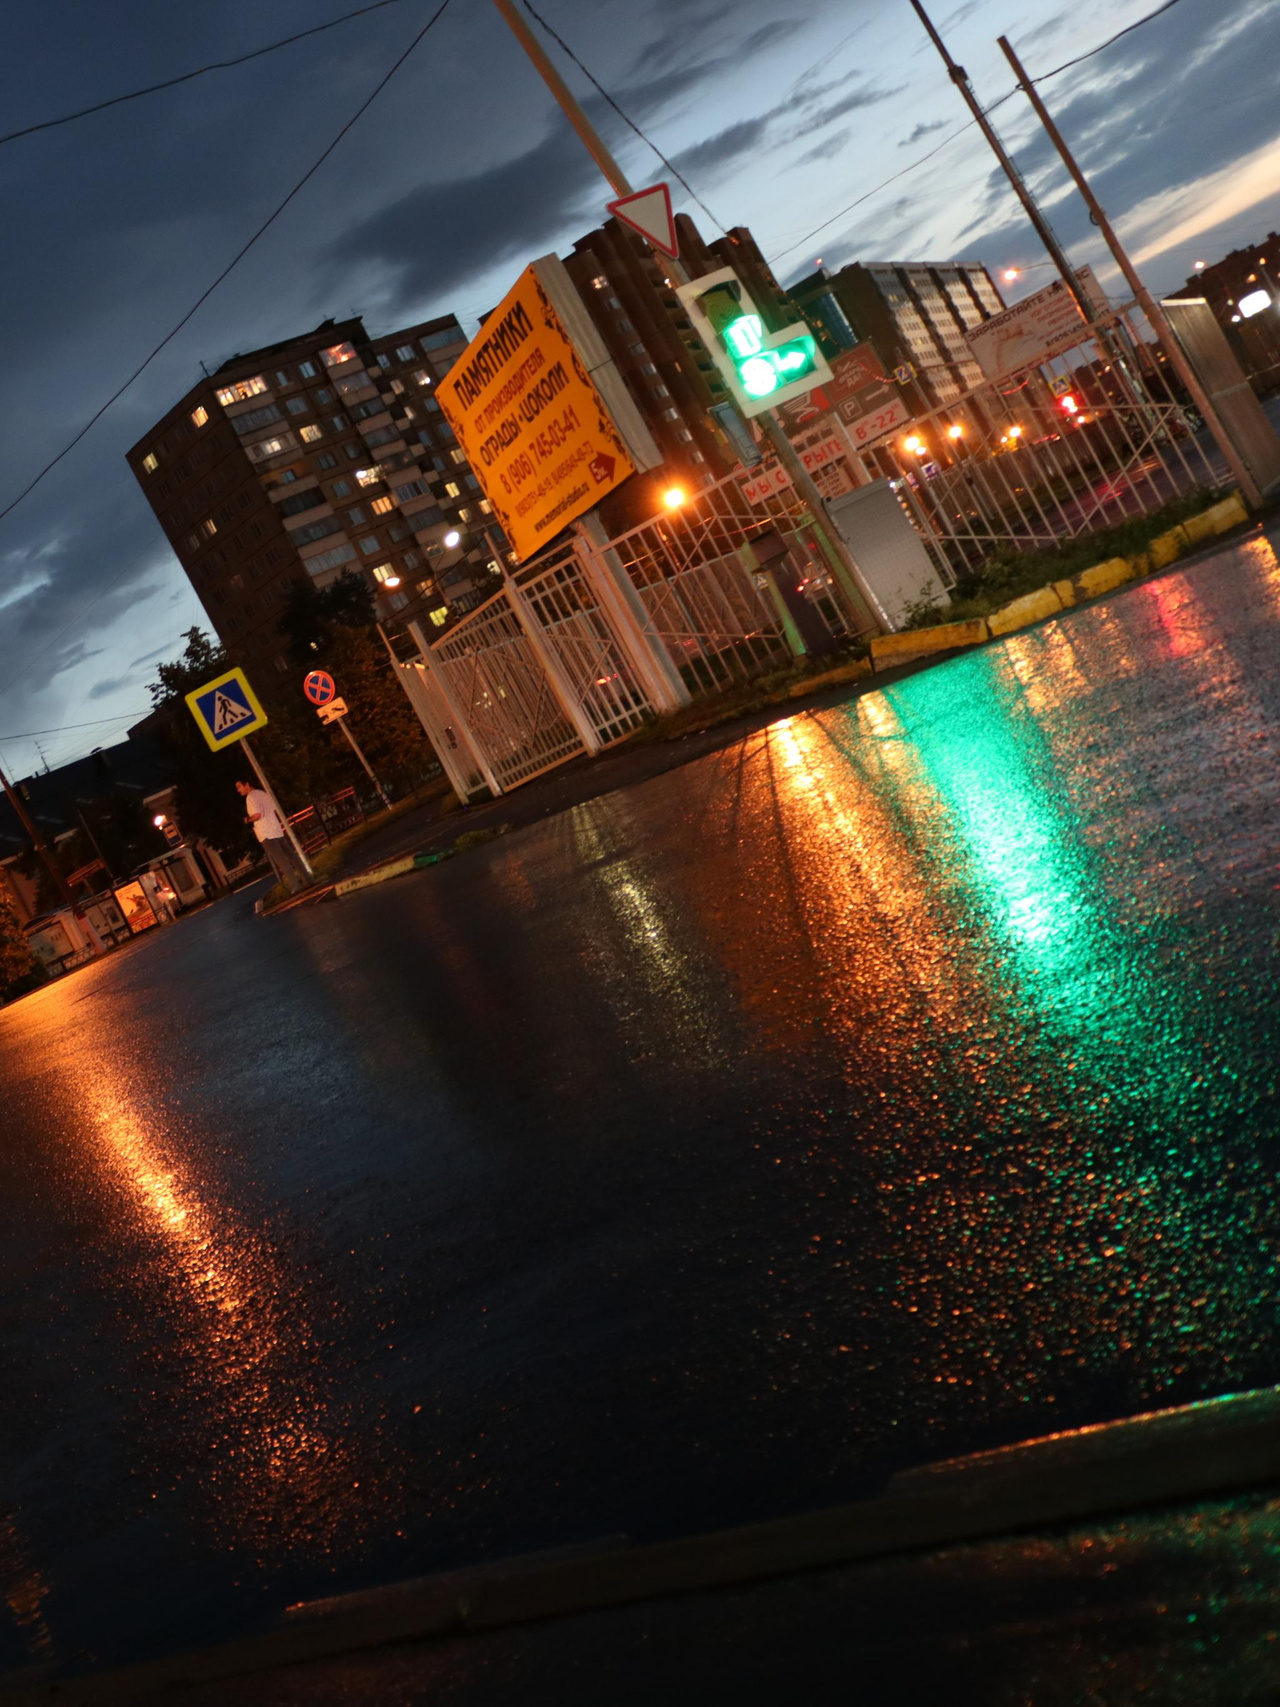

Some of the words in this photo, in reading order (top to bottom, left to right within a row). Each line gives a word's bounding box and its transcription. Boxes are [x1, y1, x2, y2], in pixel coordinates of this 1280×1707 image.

[968, 295, 1046, 342] ЗАРАБОТАЙТЕ
[453, 300, 534, 411] ПАМЯТНИКИ
[474, 414, 487, 433] ОТ
[483, 347, 546, 425] ПРОИЗВОДИТЕЛЯ
[480, 412, 522, 467] ОГРАДЫ
[528, 404, 582, 466] 745-03-41
[500, 473, 513, 495] 8
[506, 451, 538, 493] (906)
